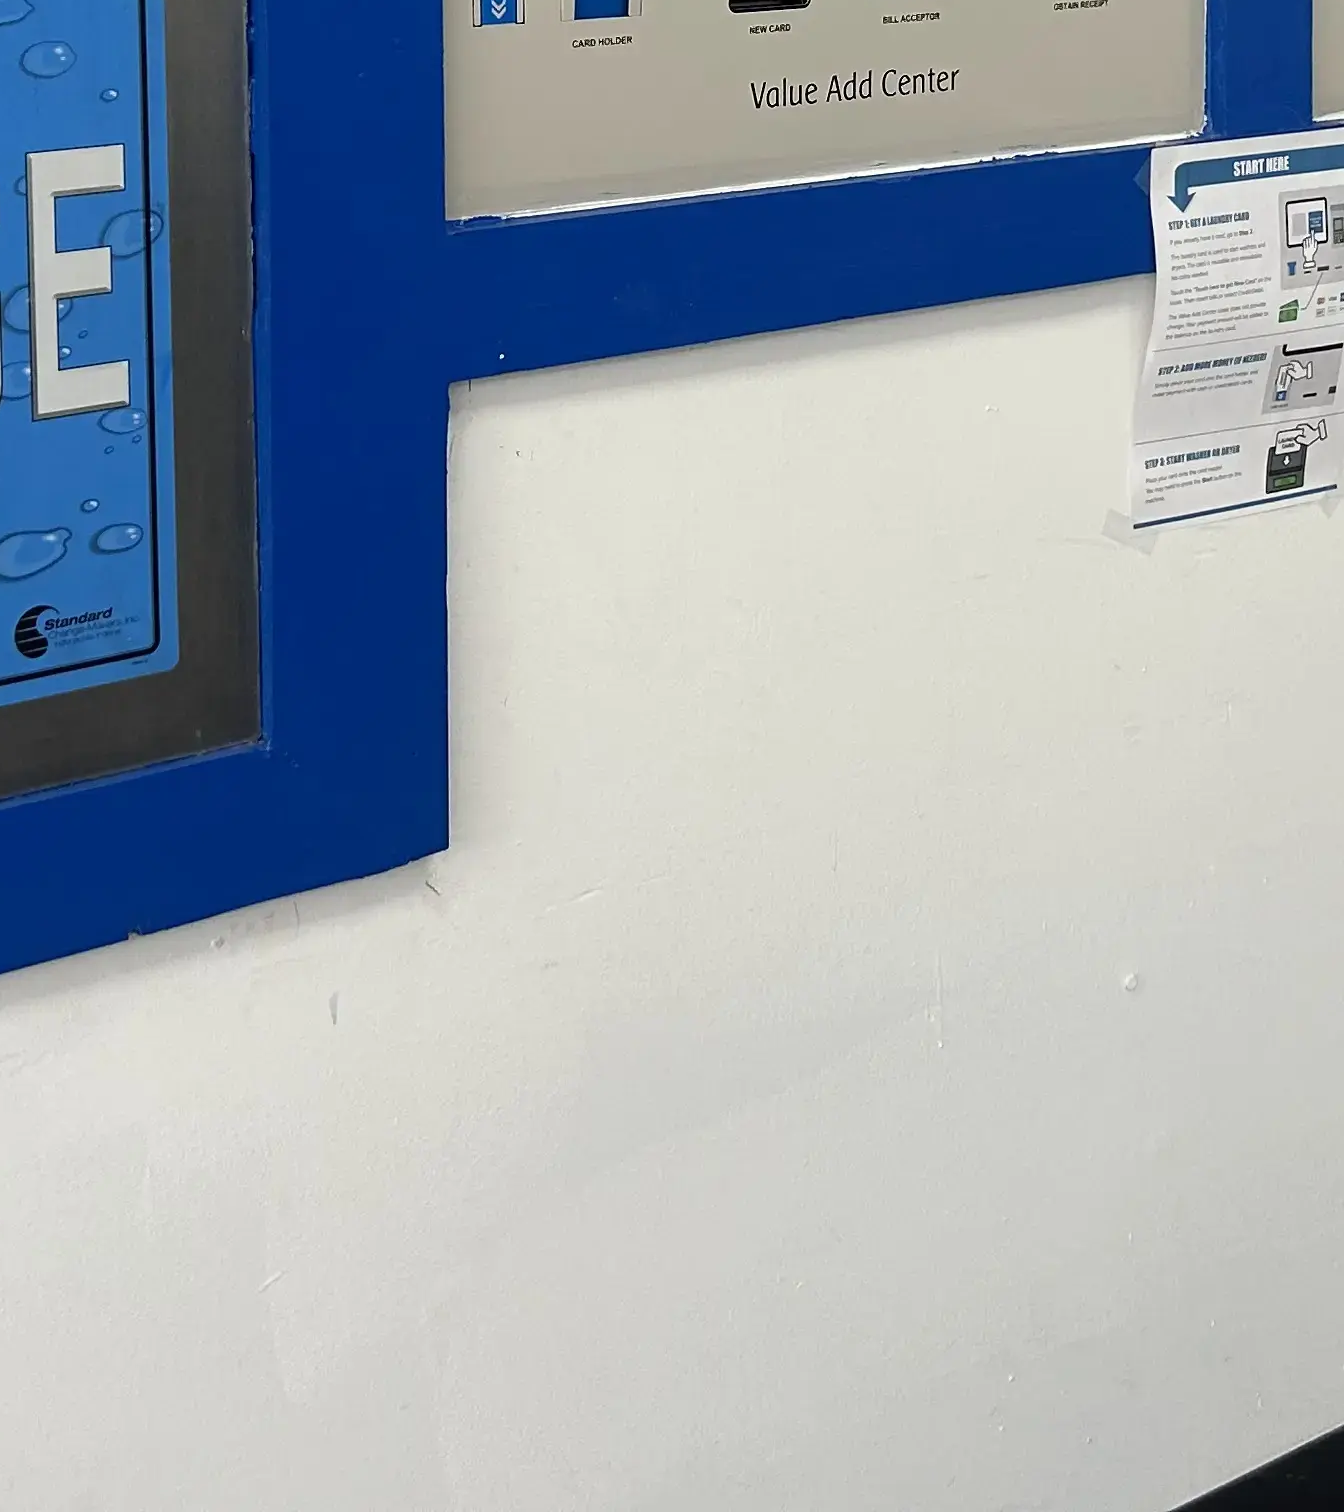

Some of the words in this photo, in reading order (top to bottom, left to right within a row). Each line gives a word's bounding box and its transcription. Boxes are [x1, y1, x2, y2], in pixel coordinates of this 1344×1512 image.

[883, 16, 899, 24] BILL
[900, 12, 940, 22] ACCEPTOR
[749, 25, 767, 34] NEW
[769, 23, 791, 33] CARD
[572, 39, 596, 48] CARD
[598, 36, 633, 46] HOLDER
[750, 77, 818, 109] Value
[826, 70, 873, 103] Add
[881, 67, 960, 98] Center
[1233, 158, 1264, 177] START
[1265, 155, 1290, 173] HERE
[1168, 220, 1184, 231] STEP
[1202, 217, 1207, 227] A
[1234, 211, 1250, 222] CARD
[1145, 460, 1158, 470] STEP
[1166, 454, 1185, 466] START
[1186, 450, 1211, 462] WASHER
[44, 607, 113, 631] Standard
